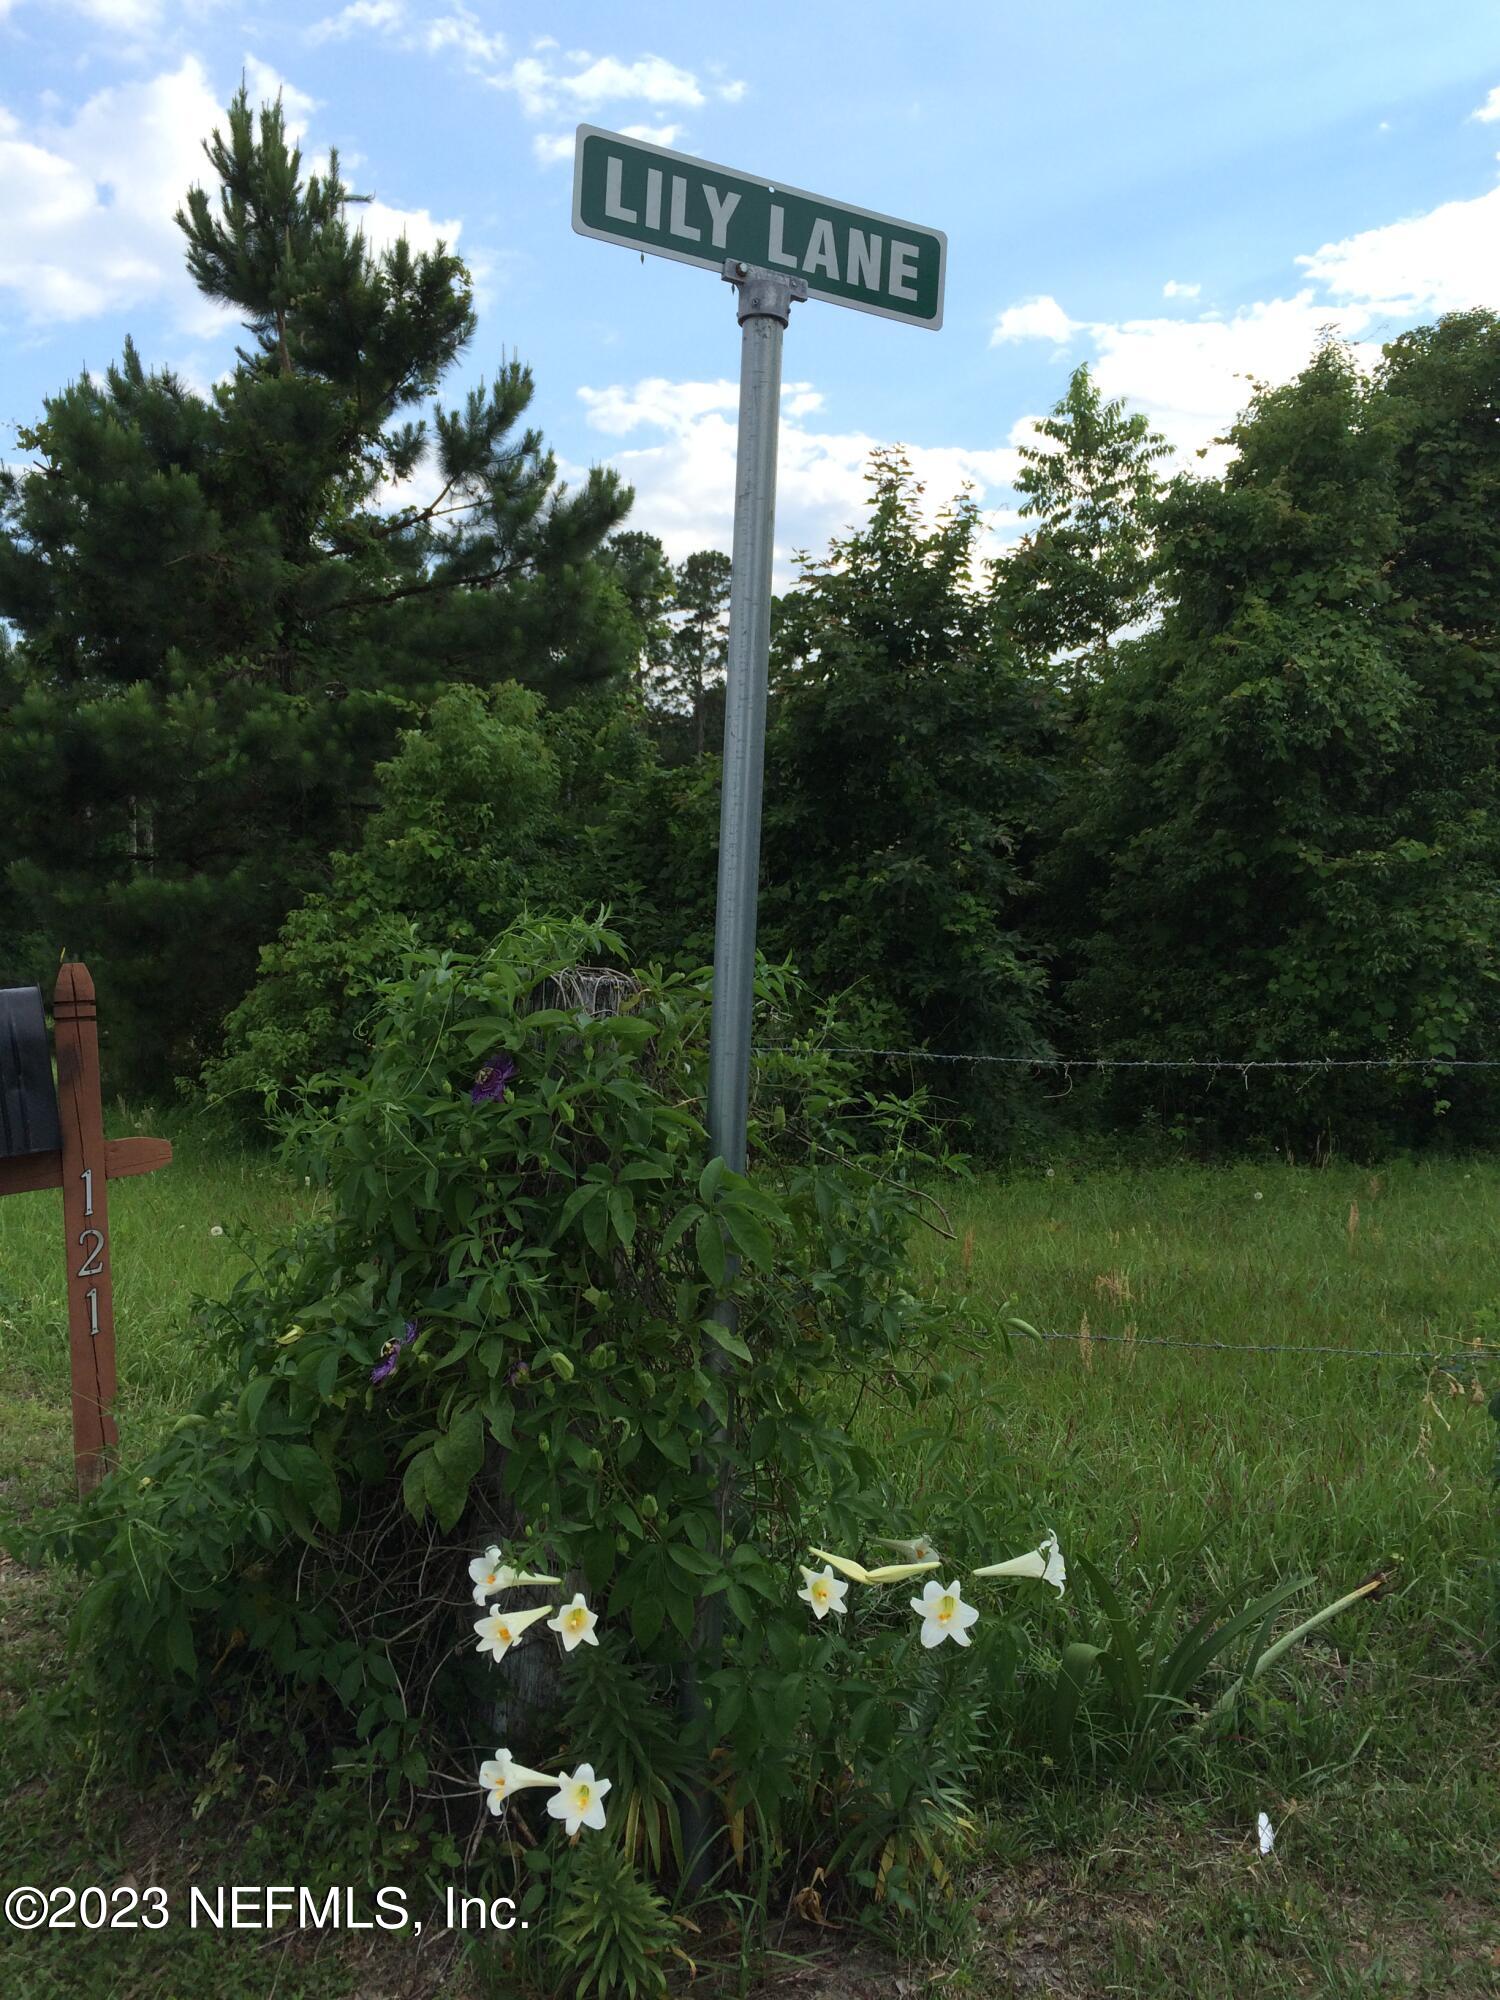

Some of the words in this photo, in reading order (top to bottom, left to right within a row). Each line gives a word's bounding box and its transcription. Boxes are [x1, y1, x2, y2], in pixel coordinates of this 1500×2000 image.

[605, 156, 741, 248] LILY
[768, 205, 920, 301] LANE
[77, 1168, 105, 1336] 121
